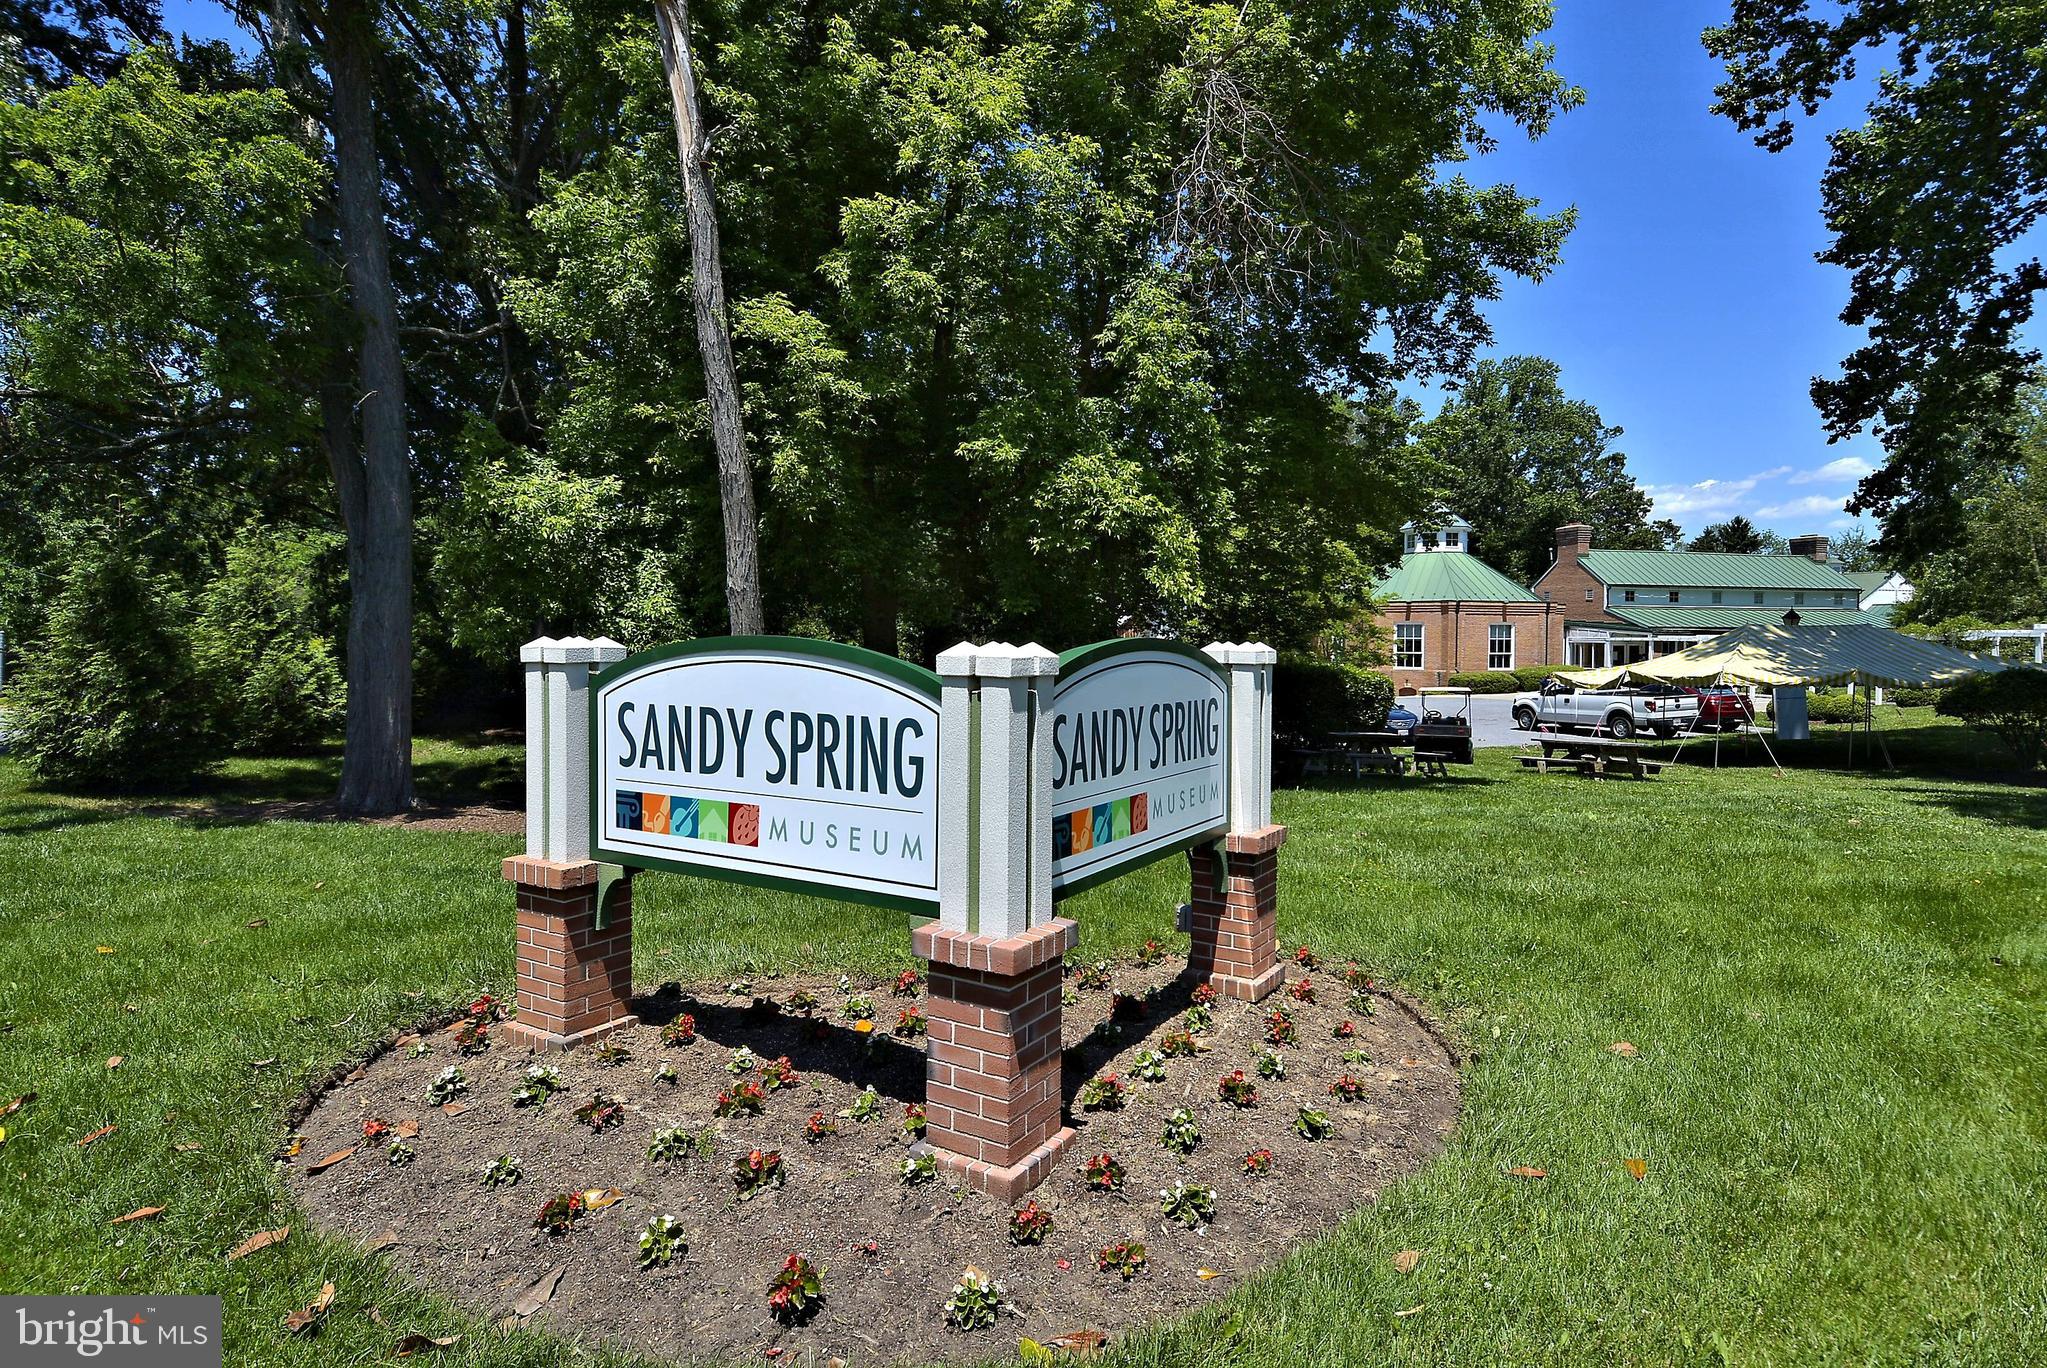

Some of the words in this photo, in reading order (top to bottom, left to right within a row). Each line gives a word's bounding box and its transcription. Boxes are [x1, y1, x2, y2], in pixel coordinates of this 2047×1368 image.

[617, 701, 753, 778] SANDY
[764, 709, 924, 798] SPRING
[1053, 706, 1144, 790] SANDY
[1150, 697, 1219, 770] SPRING
[1152, 780, 1219, 820] MUSEUM
[769, 815, 923, 861] MUSEUM
